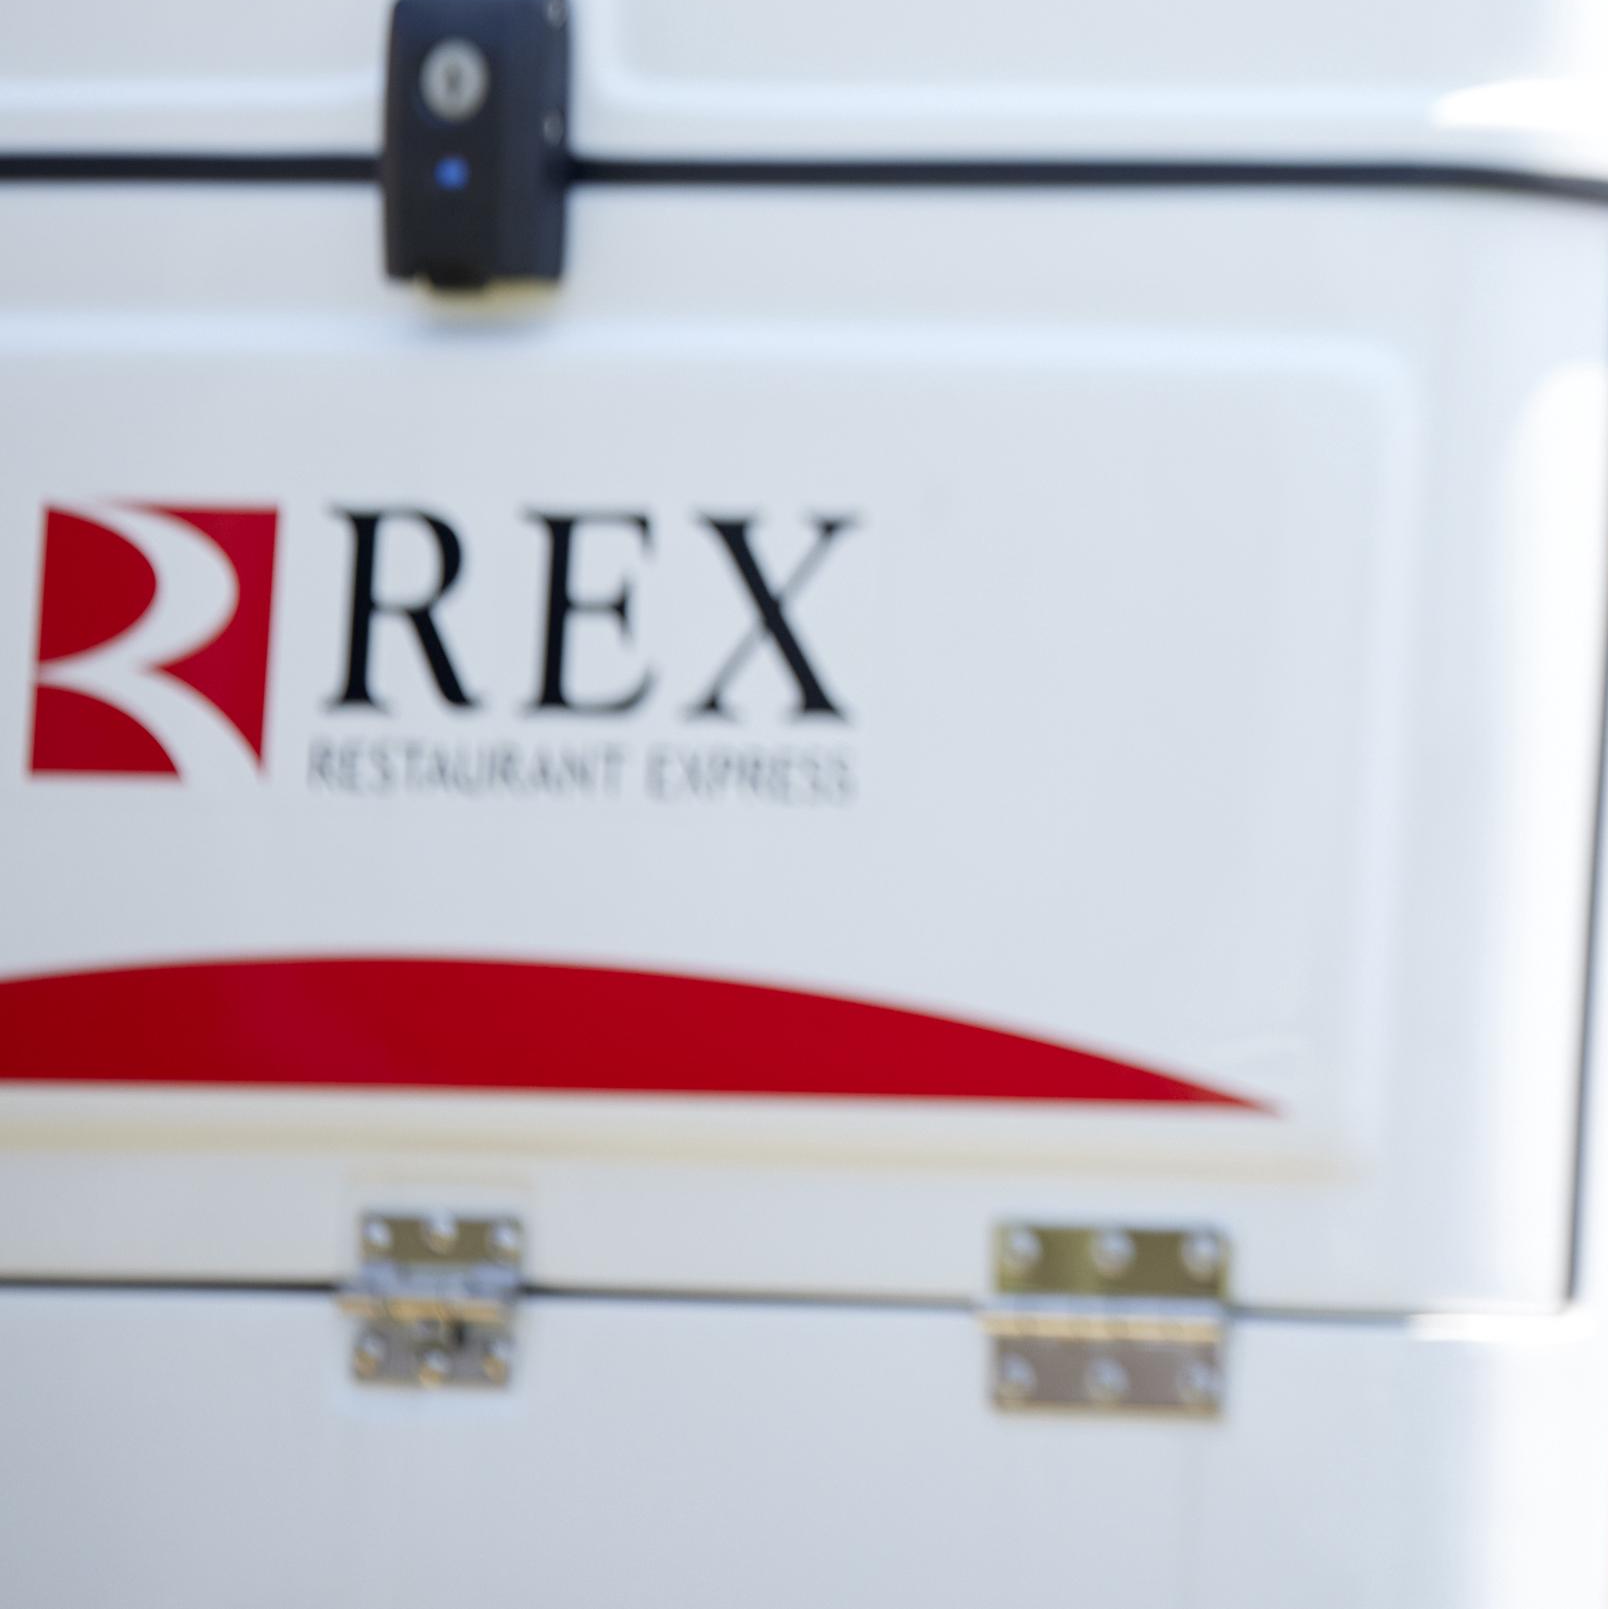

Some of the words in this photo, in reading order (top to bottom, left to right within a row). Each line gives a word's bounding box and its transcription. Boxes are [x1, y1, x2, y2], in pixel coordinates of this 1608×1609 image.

[320, 503, 858, 724] REX
[307, 734, 628, 800] RESTAURANT
[644, 742, 860, 808] EXPRESS
